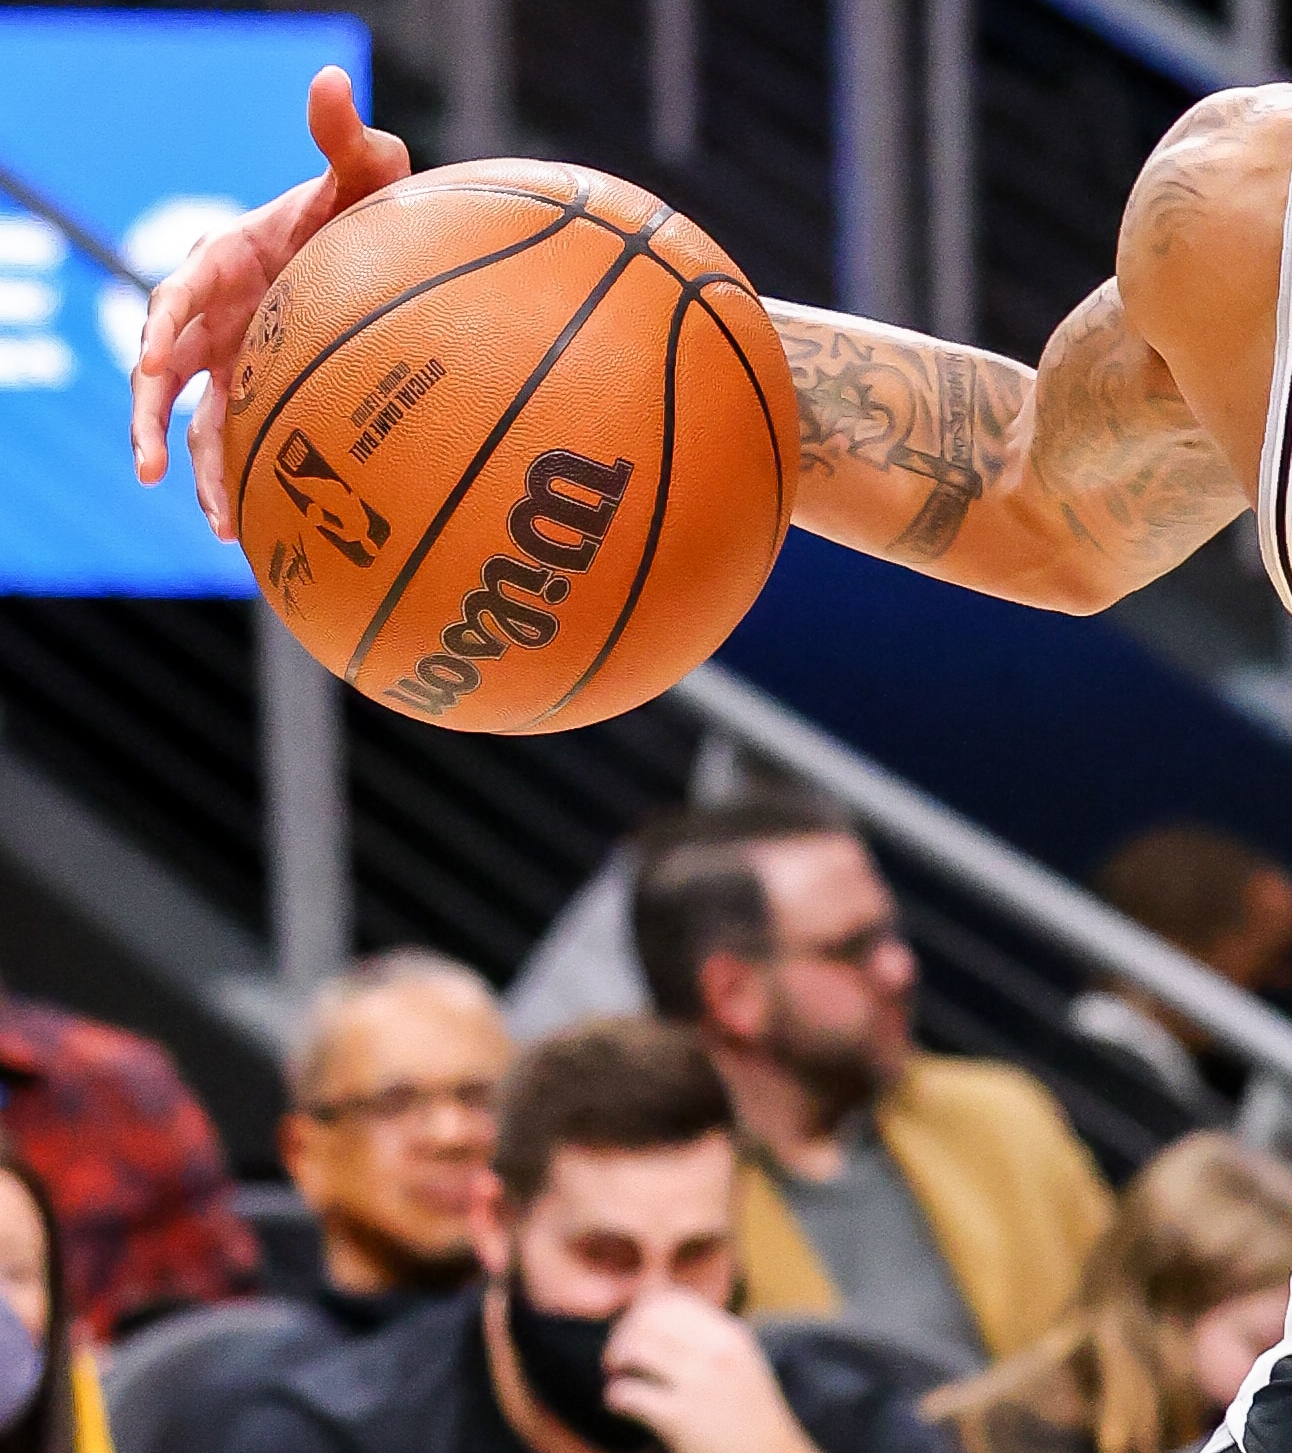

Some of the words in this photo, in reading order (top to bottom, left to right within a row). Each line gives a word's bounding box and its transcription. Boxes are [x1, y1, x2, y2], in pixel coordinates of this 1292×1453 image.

[394, 358, 447, 410] OFFICIAL
[369, 400, 404, 441] GAME
[348, 430, 381, 464] BALL
[383, 449, 635, 716] Wilson
